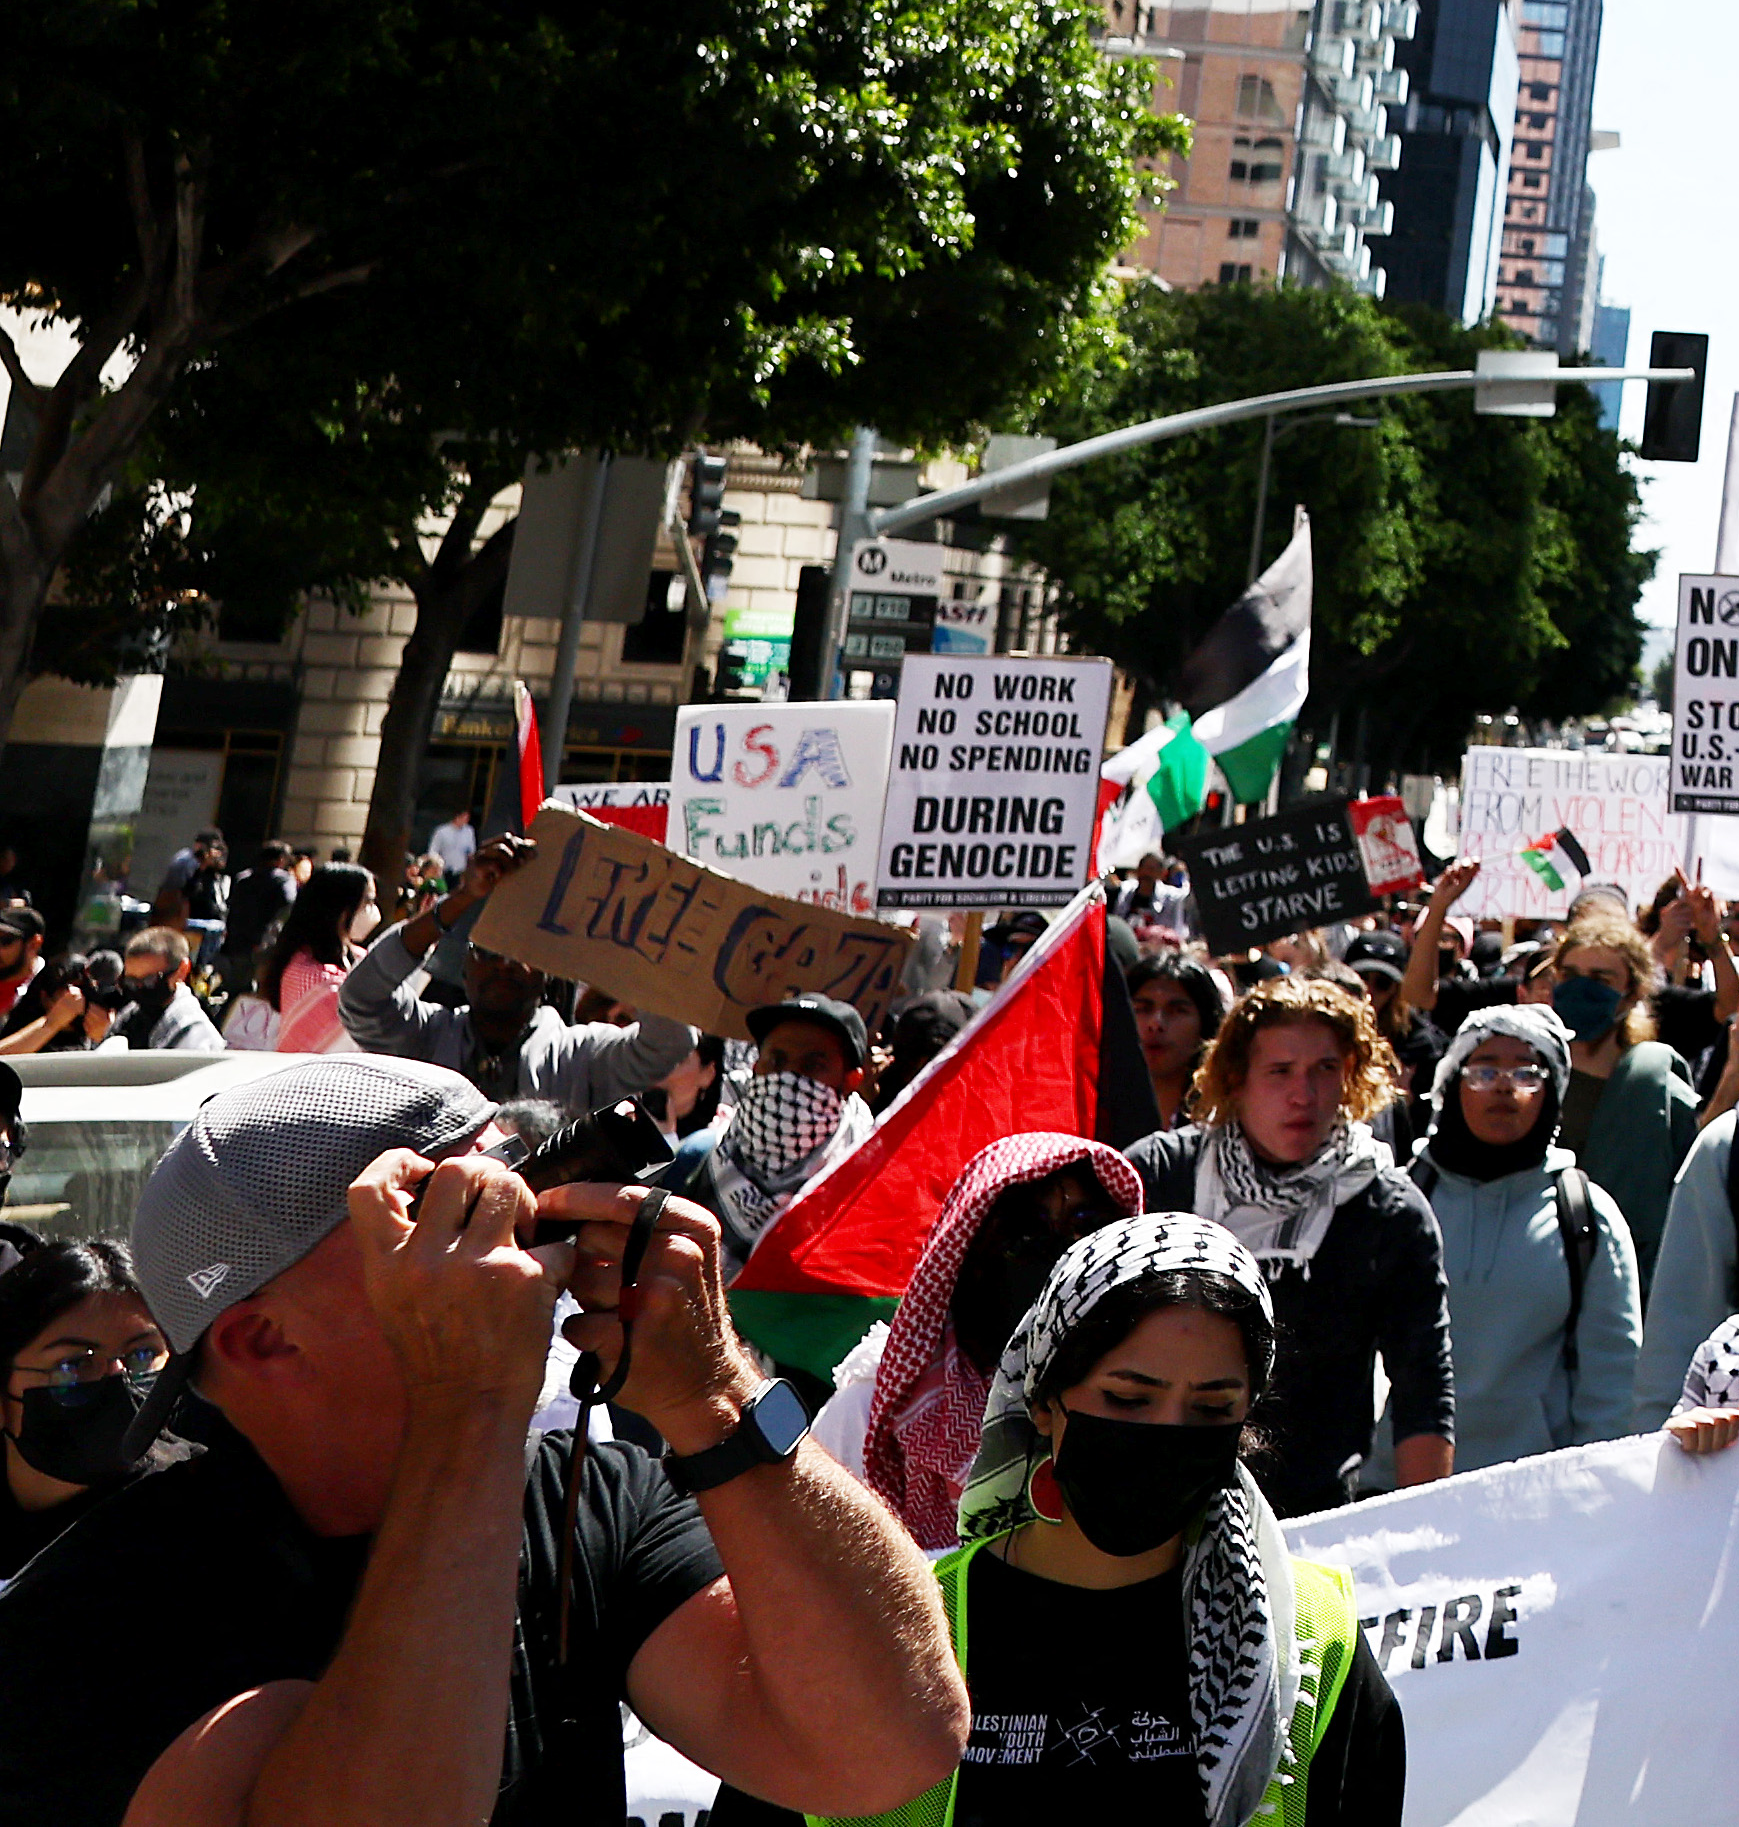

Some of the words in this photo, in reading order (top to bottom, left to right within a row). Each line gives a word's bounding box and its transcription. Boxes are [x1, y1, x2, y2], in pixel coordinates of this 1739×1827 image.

[1687, 637, 1738, 678] ON
[934, 673, 974, 699] NO
[993, 675, 1077, 703] WORK
[917, 709, 957, 735] NO
[975, 710, 1082, 739] SCHOOL
[688, 723, 853, 790] USA
[899, 744, 939, 771] NO
[949, 745, 1092, 774] SPENDING
[1472, 754, 1542, 789] FREE
[1554, 759, 1601, 792] THE
[1606, 764, 1671, 797] WOR
[1681, 765, 1733, 789] WAR
[571, 788, 618, 809] WE
[632, 788, 671, 808] AR
[912, 796, 1065, 835] DURING
[1469, 789, 1542, 834] FROM
[682, 795, 856, 859] Funds
[1201, 842, 1244, 868] THE
[1255, 833, 1299, 854] U.S.
[1314, 822, 1343, 844] IS
[889, 843, 1077, 879] GENOCIDE
[1212, 864, 1301, 900] LETTING
[1305, 849, 1362, 878] KIDS
[1240, 881, 1345, 931] STARVE
